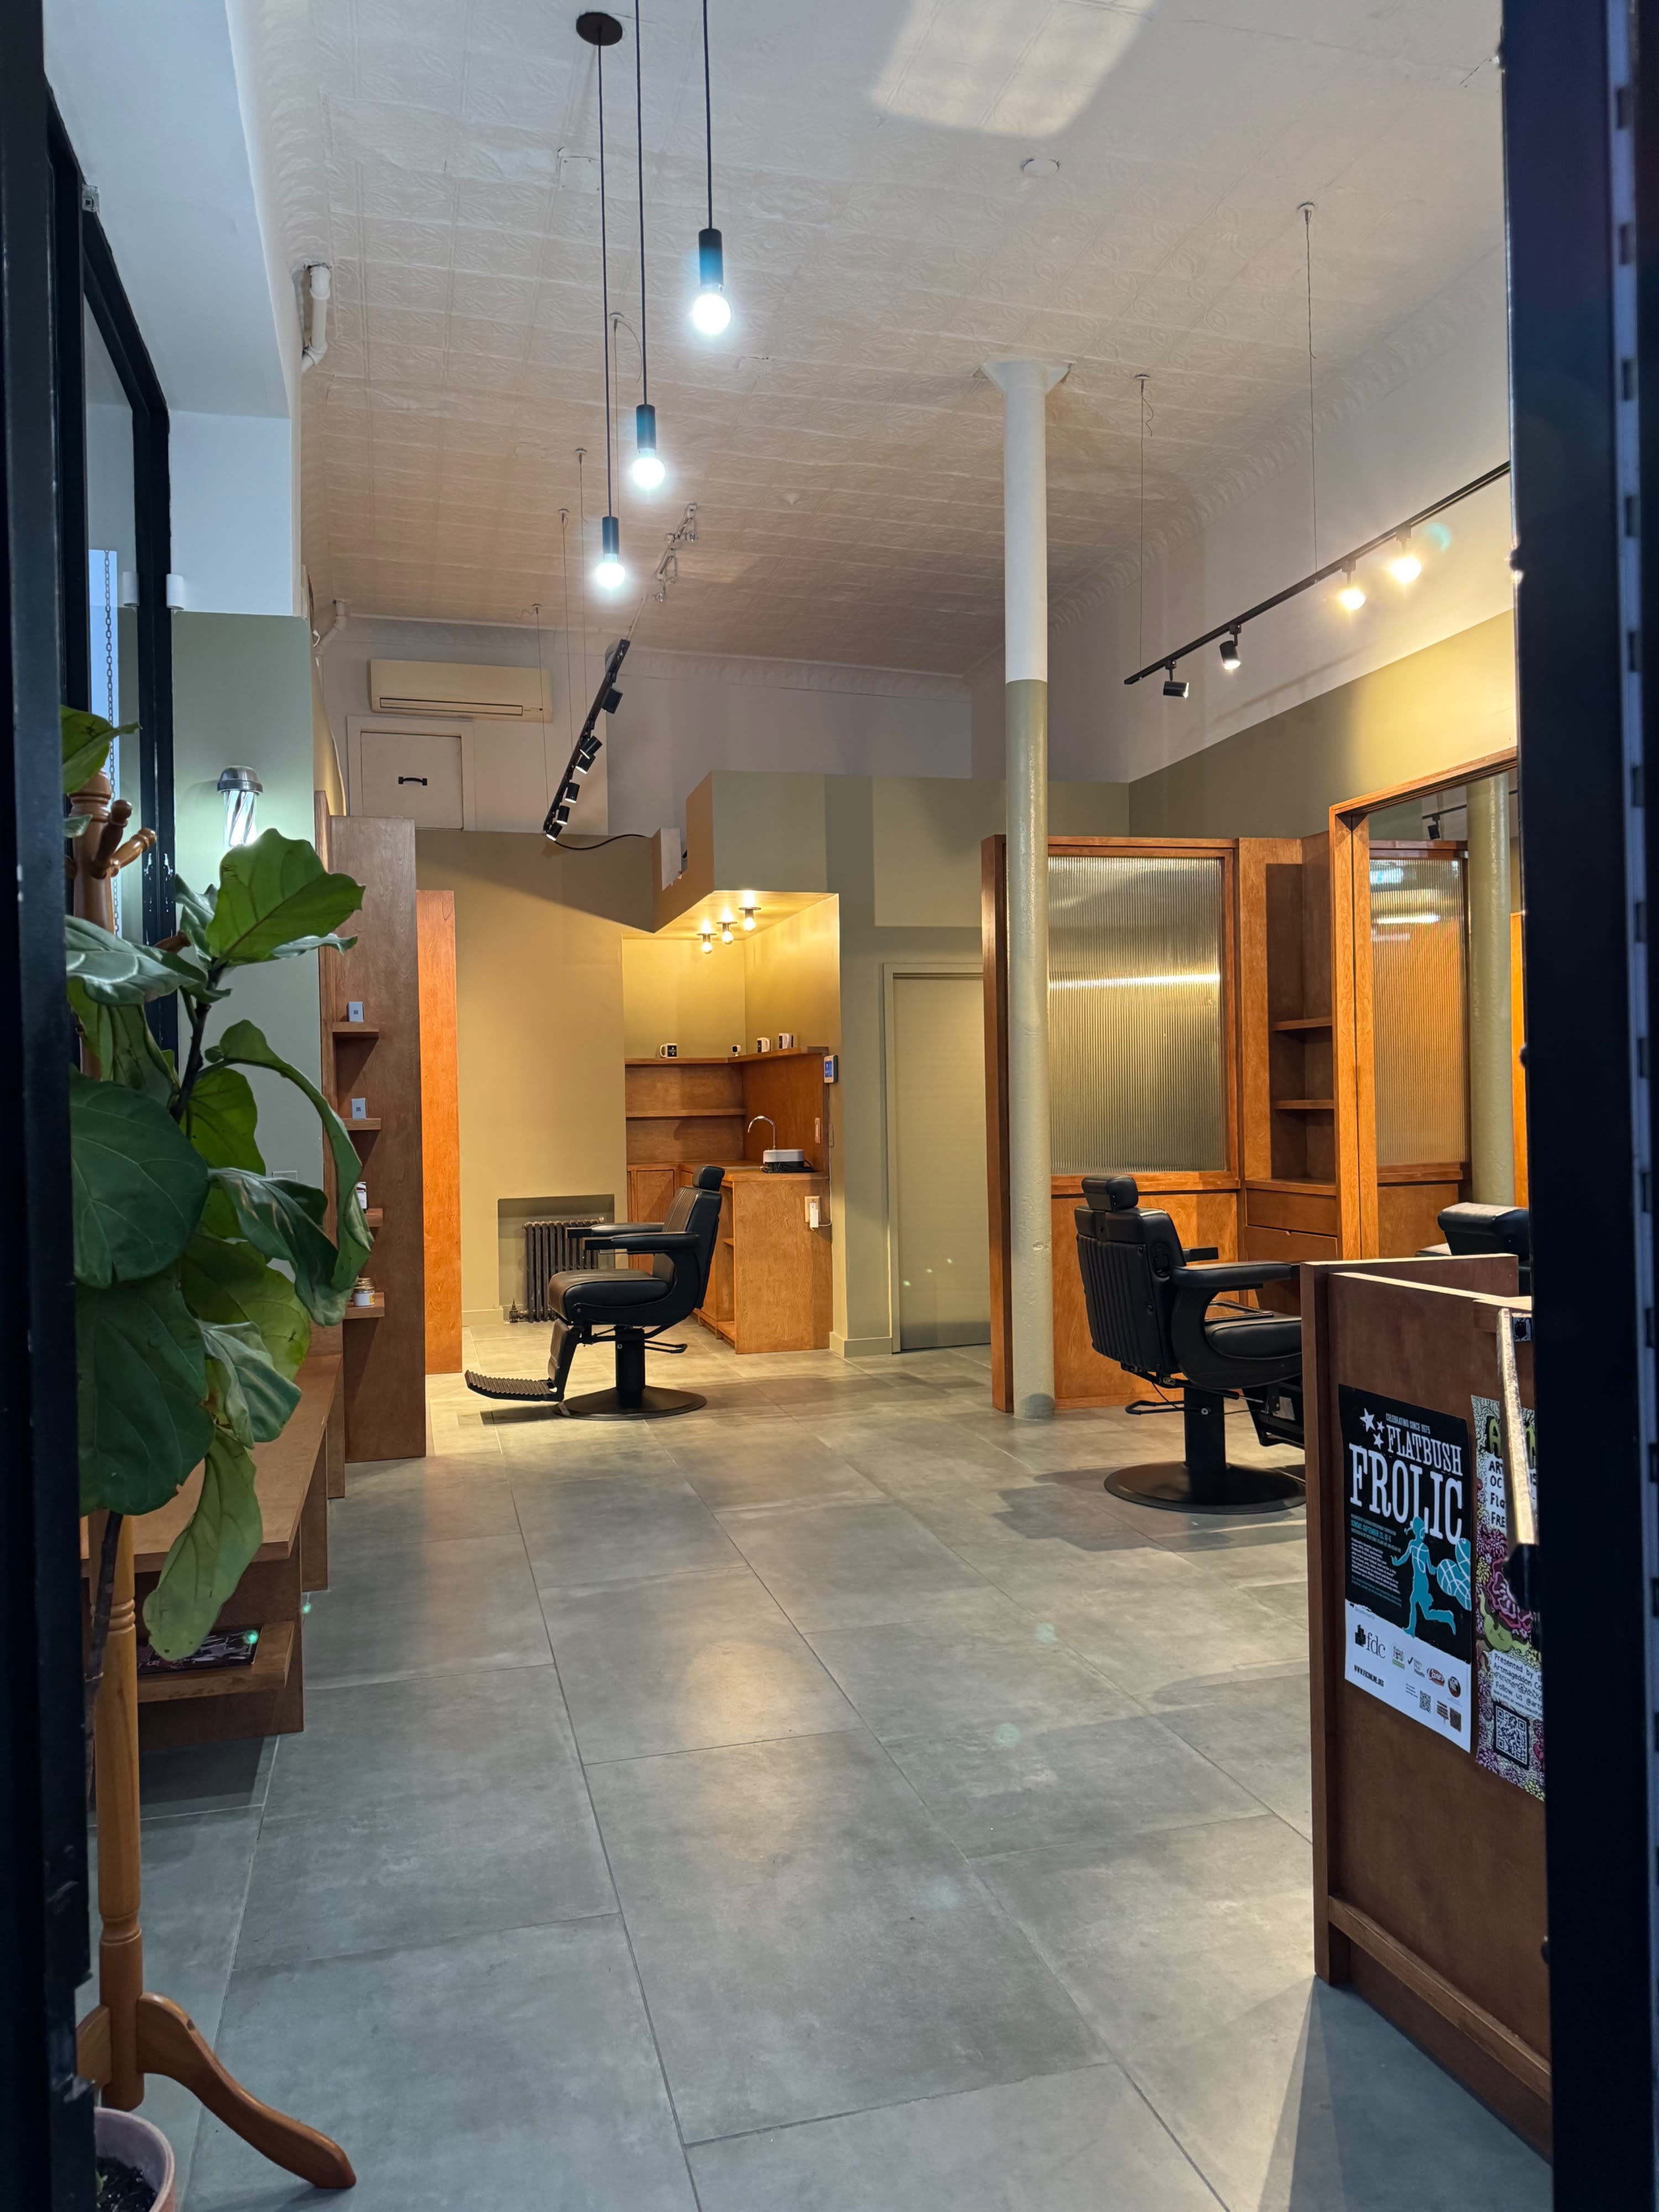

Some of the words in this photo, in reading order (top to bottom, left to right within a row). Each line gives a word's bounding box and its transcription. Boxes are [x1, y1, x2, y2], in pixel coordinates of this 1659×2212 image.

[1386, 1424, 1463, 1476] FLATBUSH
[1349, 1443, 1463, 1545] FROLIC
[1366, 1632, 1385, 1659] fdc
[1494, 1653, 1523, 1673] Presented
[1526, 1668, 1533, 1679] by
[1494, 1662, 1532, 1687] Artmageddon
[1496, 1681, 1512, 1695] Follow
[1516, 1693, 1522, 1701] us
